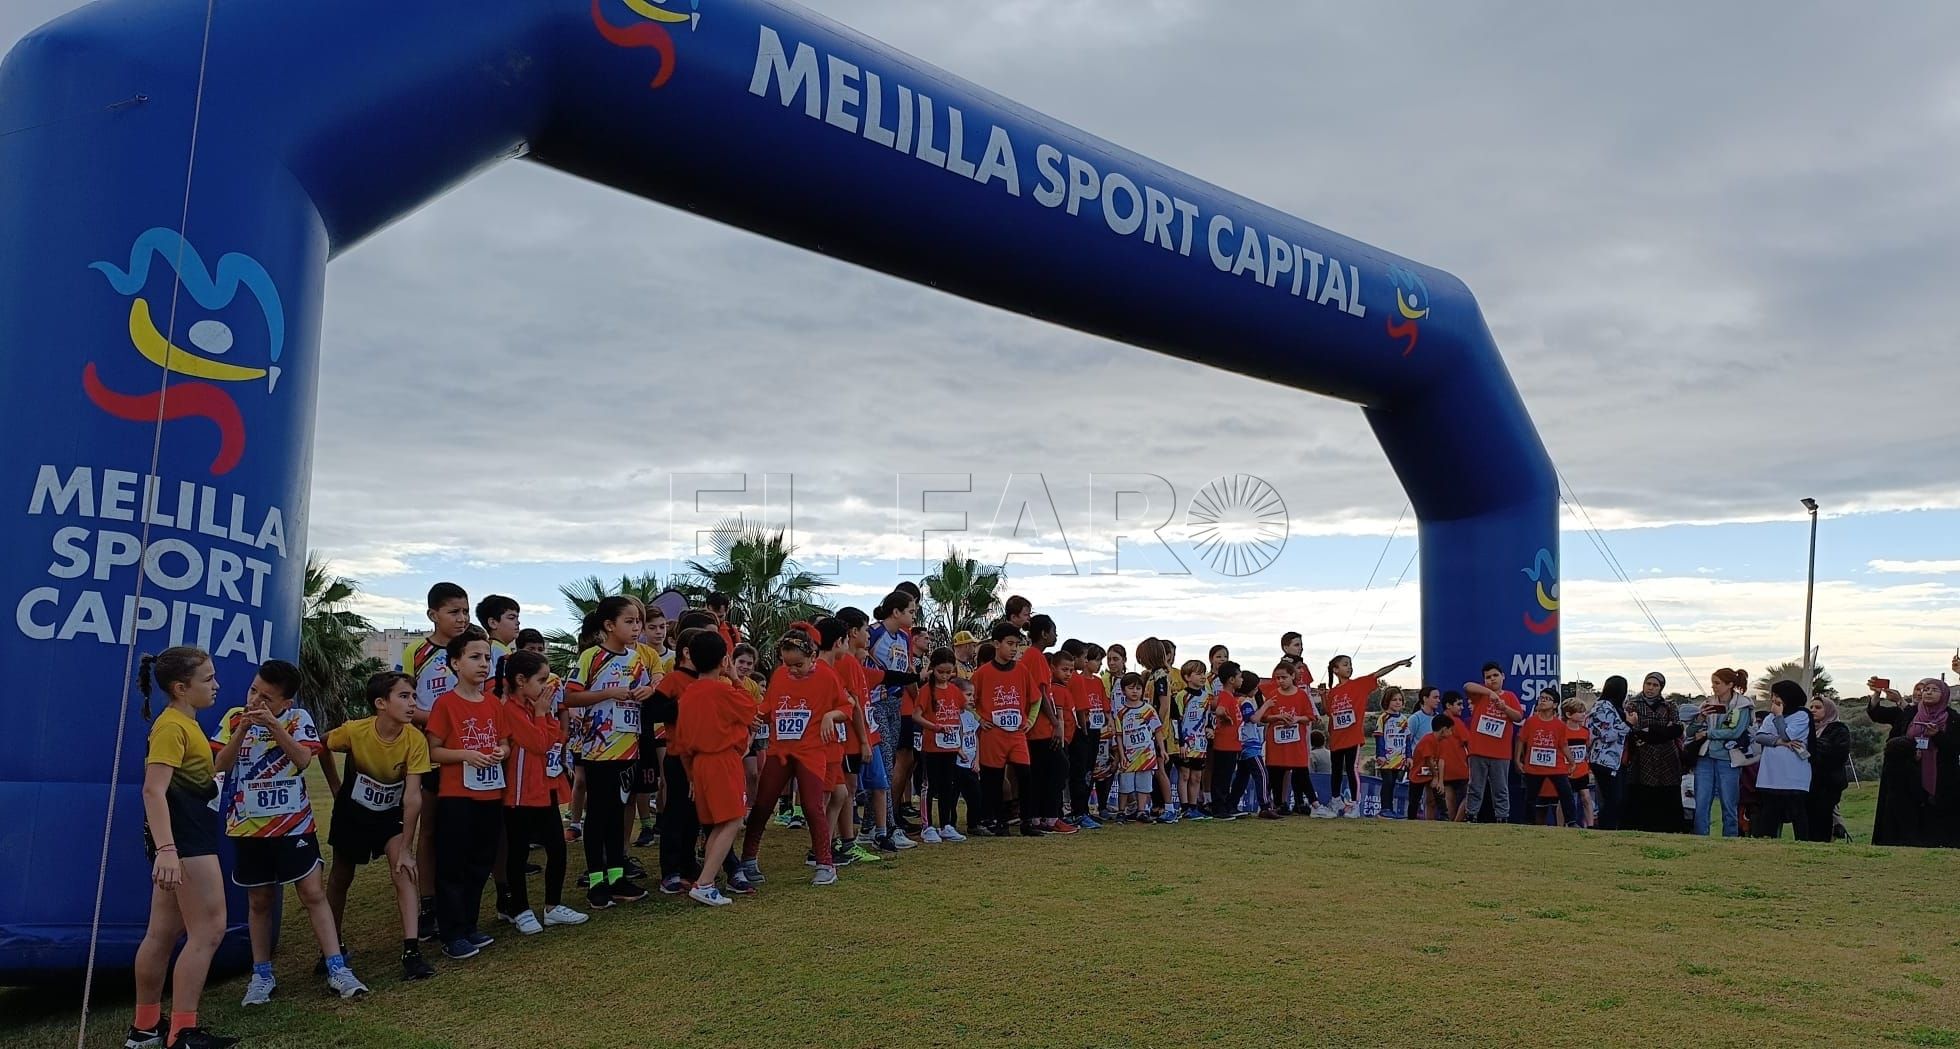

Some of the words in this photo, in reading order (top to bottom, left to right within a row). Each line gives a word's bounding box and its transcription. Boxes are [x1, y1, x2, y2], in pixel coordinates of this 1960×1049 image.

[748, 25, 1020, 197] MELILLA
[1032, 143, 1199, 257] SPORT
[1208, 215, 1367, 318] CAPITAL
[28, 464, 287, 559] MELILLA
[48, 526, 272, 608] SPORT
[16, 586, 274, 666] CAPITAL
[778, 719, 804, 733] 829
[1000, 714, 1019, 726] 830
[1485, 721, 1500, 733] 917
[1129, 731, 1147, 745] 813
[1280, 729, 1295, 739] 857
[1535, 752, 1552, 762] 915
[476, 766, 499, 781] 916
[257, 788, 289, 808] 876
[364, 786, 396, 805] 906
